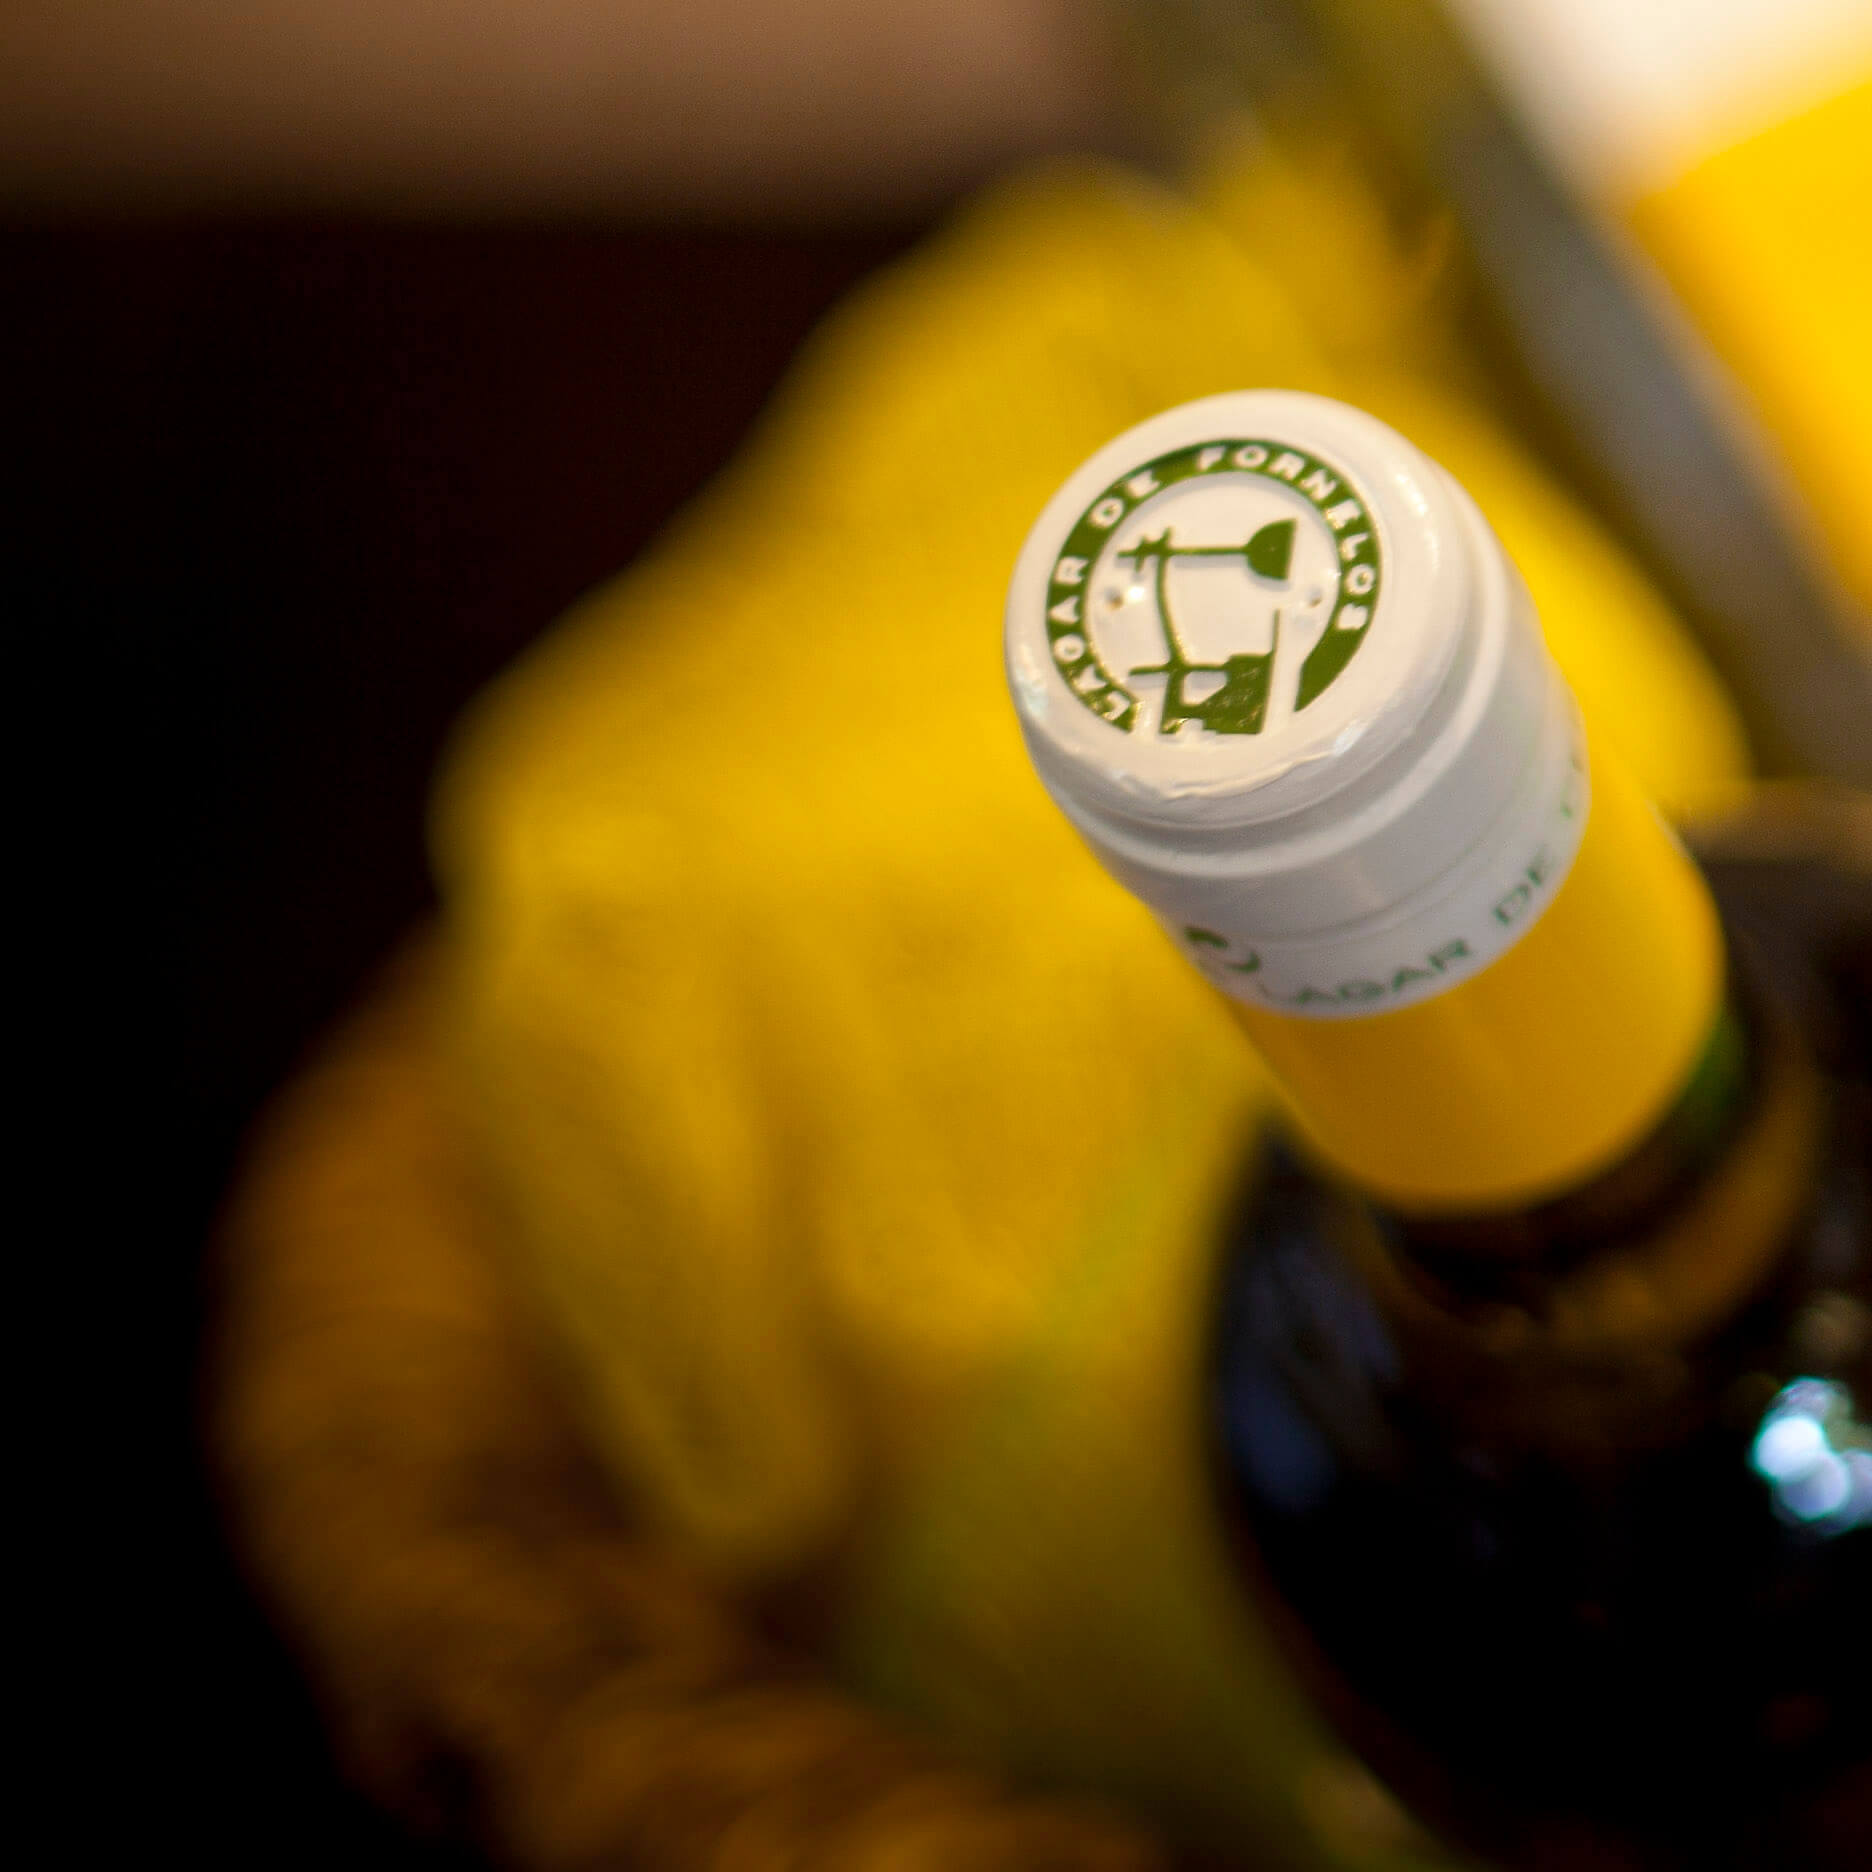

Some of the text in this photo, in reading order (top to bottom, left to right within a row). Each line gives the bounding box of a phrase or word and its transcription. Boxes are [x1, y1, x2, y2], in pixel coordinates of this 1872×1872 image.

[1049, 444, 1376, 721] LAGAR DE FORNELOS
[1259, 844, 1552, 1005] LAGAR DE
